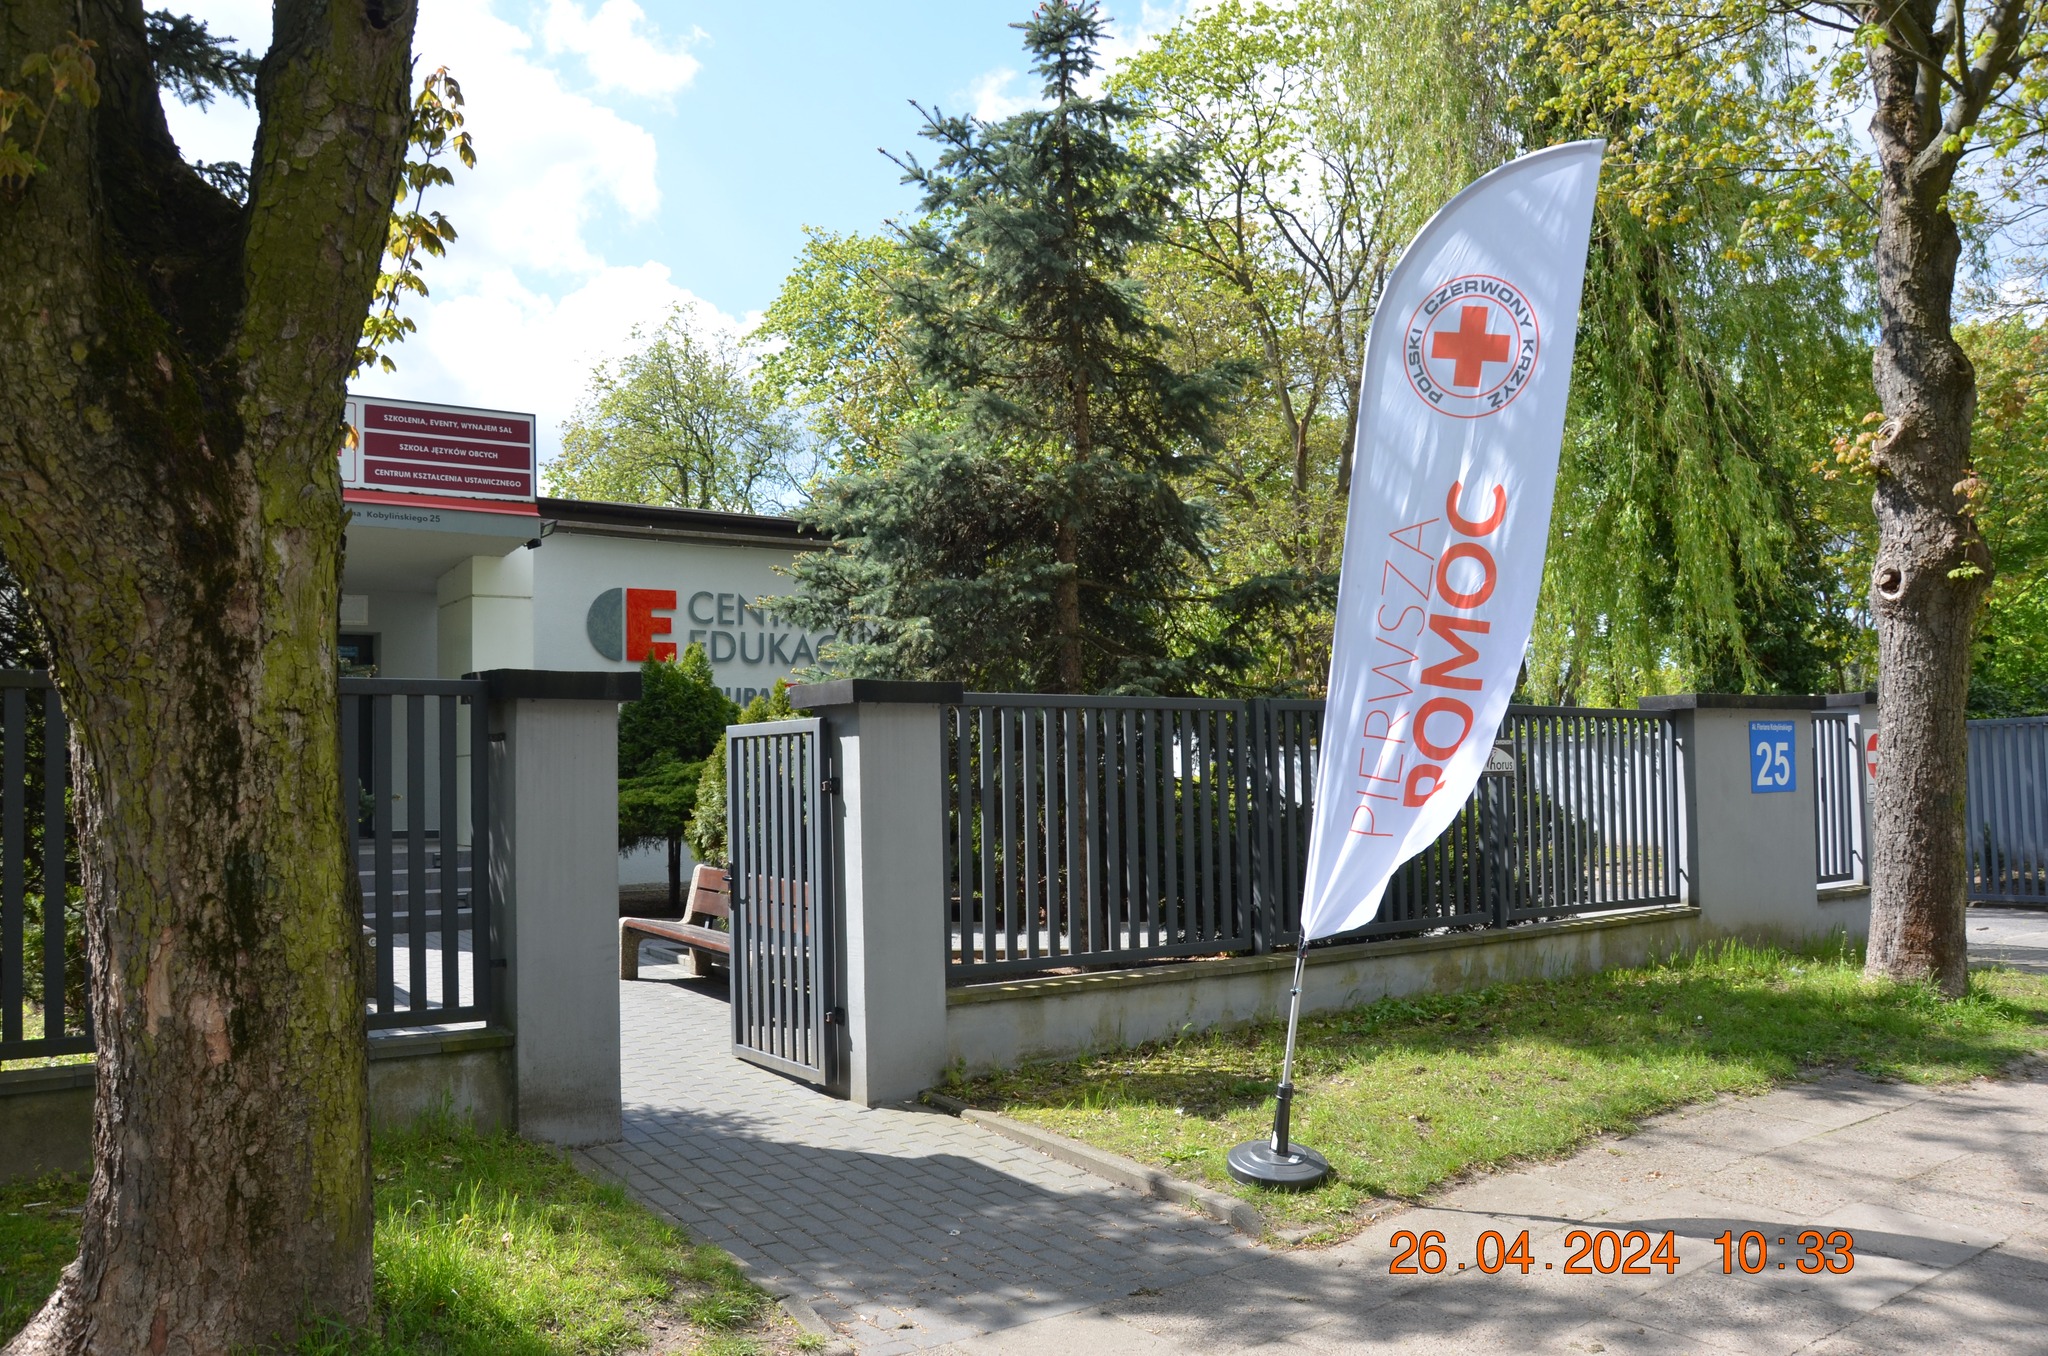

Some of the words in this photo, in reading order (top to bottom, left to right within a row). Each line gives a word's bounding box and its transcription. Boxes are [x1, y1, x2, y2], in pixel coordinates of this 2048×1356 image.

[1423, 280, 1533, 328] CZERWONY
[1408, 328, 1443, 404] POLSKI
[1487, 339, 1534, 410] KRZYŻ
[383, 414, 428, 426] SZKOLENIA,
[429, 419, 460, 430] EVENTY,
[461, 422, 498, 433] WYNAJEM
[499, 426, 513, 434] SAL
[399, 443, 429, 453] SZKOŁA
[431, 446, 467, 457] JĘZYKÓW
[468, 450, 498, 459] OBCYCH
[374, 468, 411, 479] CENTRUM
[412, 472, 463, 483] KSZTAŁCENIA
[464, 476, 522, 488] USTAWICZNEGO
[366, 511, 428, 523] Kobylińskiego
[429, 514, 441, 523] 25
[1402, 480, 1507, 808] POMOC
[1350, 518, 1440, 837] PIERWSZA
[1756, 741, 1790, 786] 25
